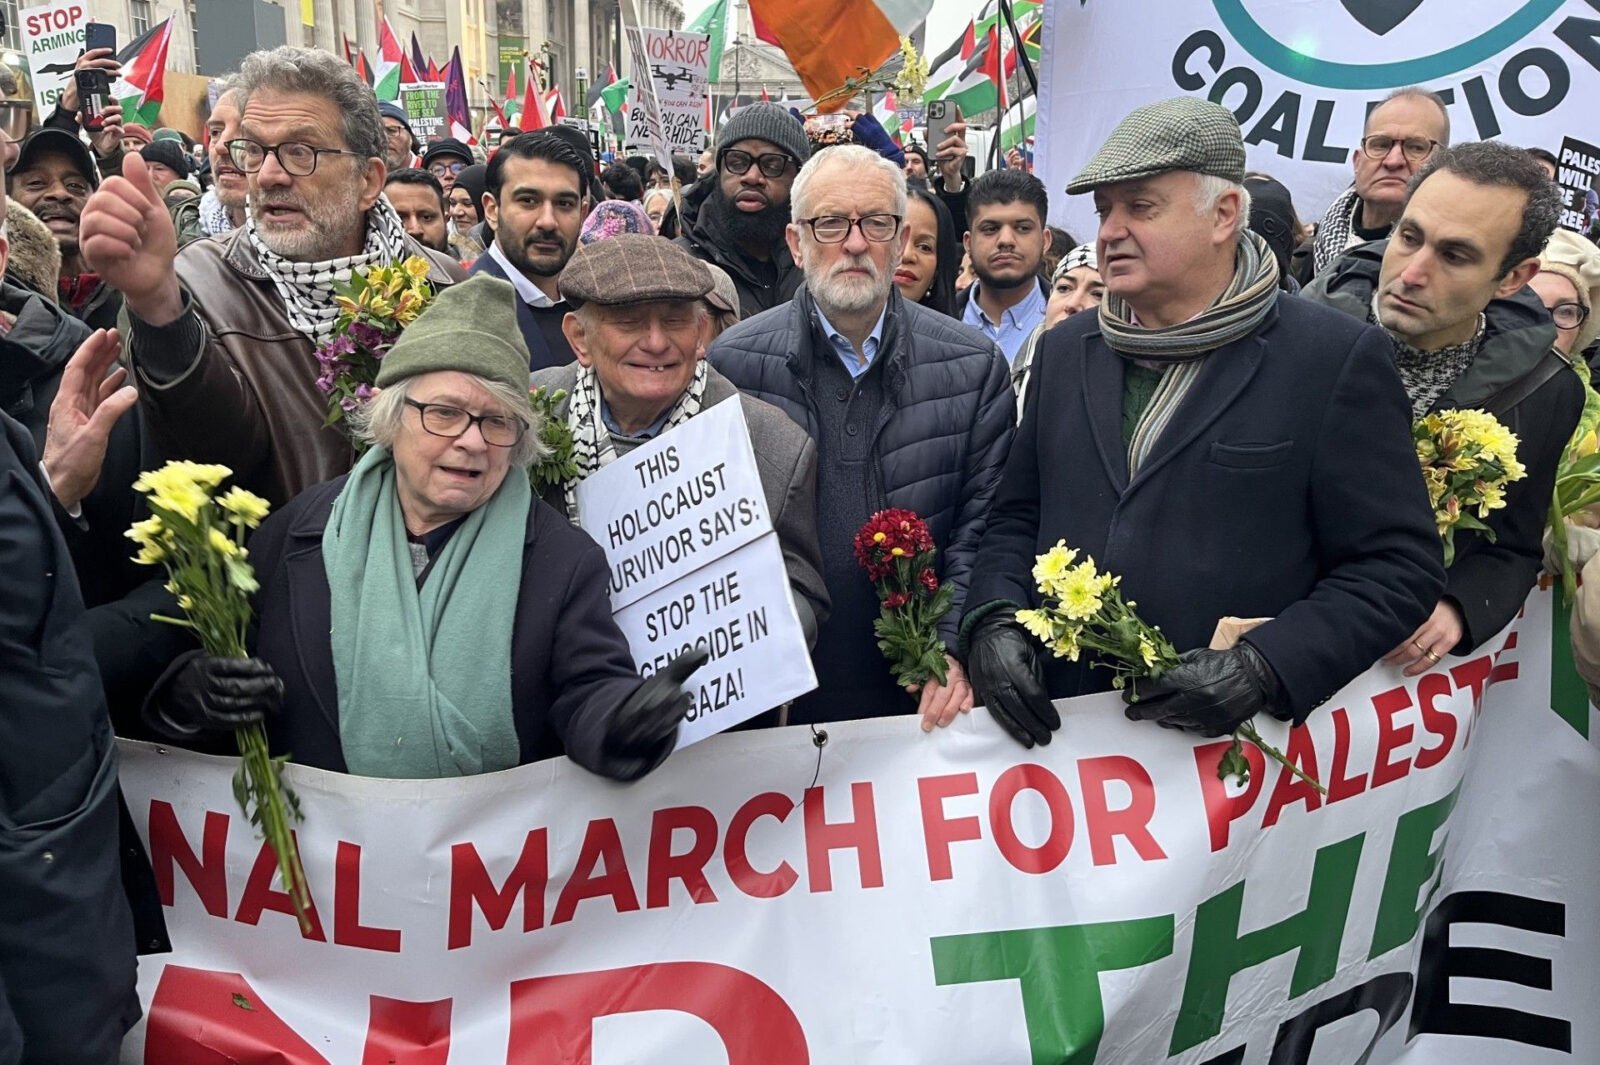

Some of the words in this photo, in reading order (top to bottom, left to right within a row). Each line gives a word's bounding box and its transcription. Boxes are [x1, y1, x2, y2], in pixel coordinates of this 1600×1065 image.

[26, 6, 82, 36] STOP
[32, 29, 86, 54] ARMING
[631, 108, 647, 123] BU
[677, 113, 700, 127] CAN
[671, 126, 702, 145] HIDE
[1561, 147, 1600, 175] PALES
[1559, 166, 1592, 191] WILL
[1558, 208, 1585, 230] REE
[634, 446, 680, 488] THIS
[607, 462, 726, 550] HOLOCAUST
[607, 527, 696, 597] URVIVOR
[699, 497, 760, 546] SAYS:
[646, 593, 695, 642] STOP
[700, 571, 741, 615] THE
[747, 606, 768, 643] IN
[684, 668, 745, 722] GAZA!
[448, 781, 884, 950] MARCH
[917, 754, 1168, 883] FOR
